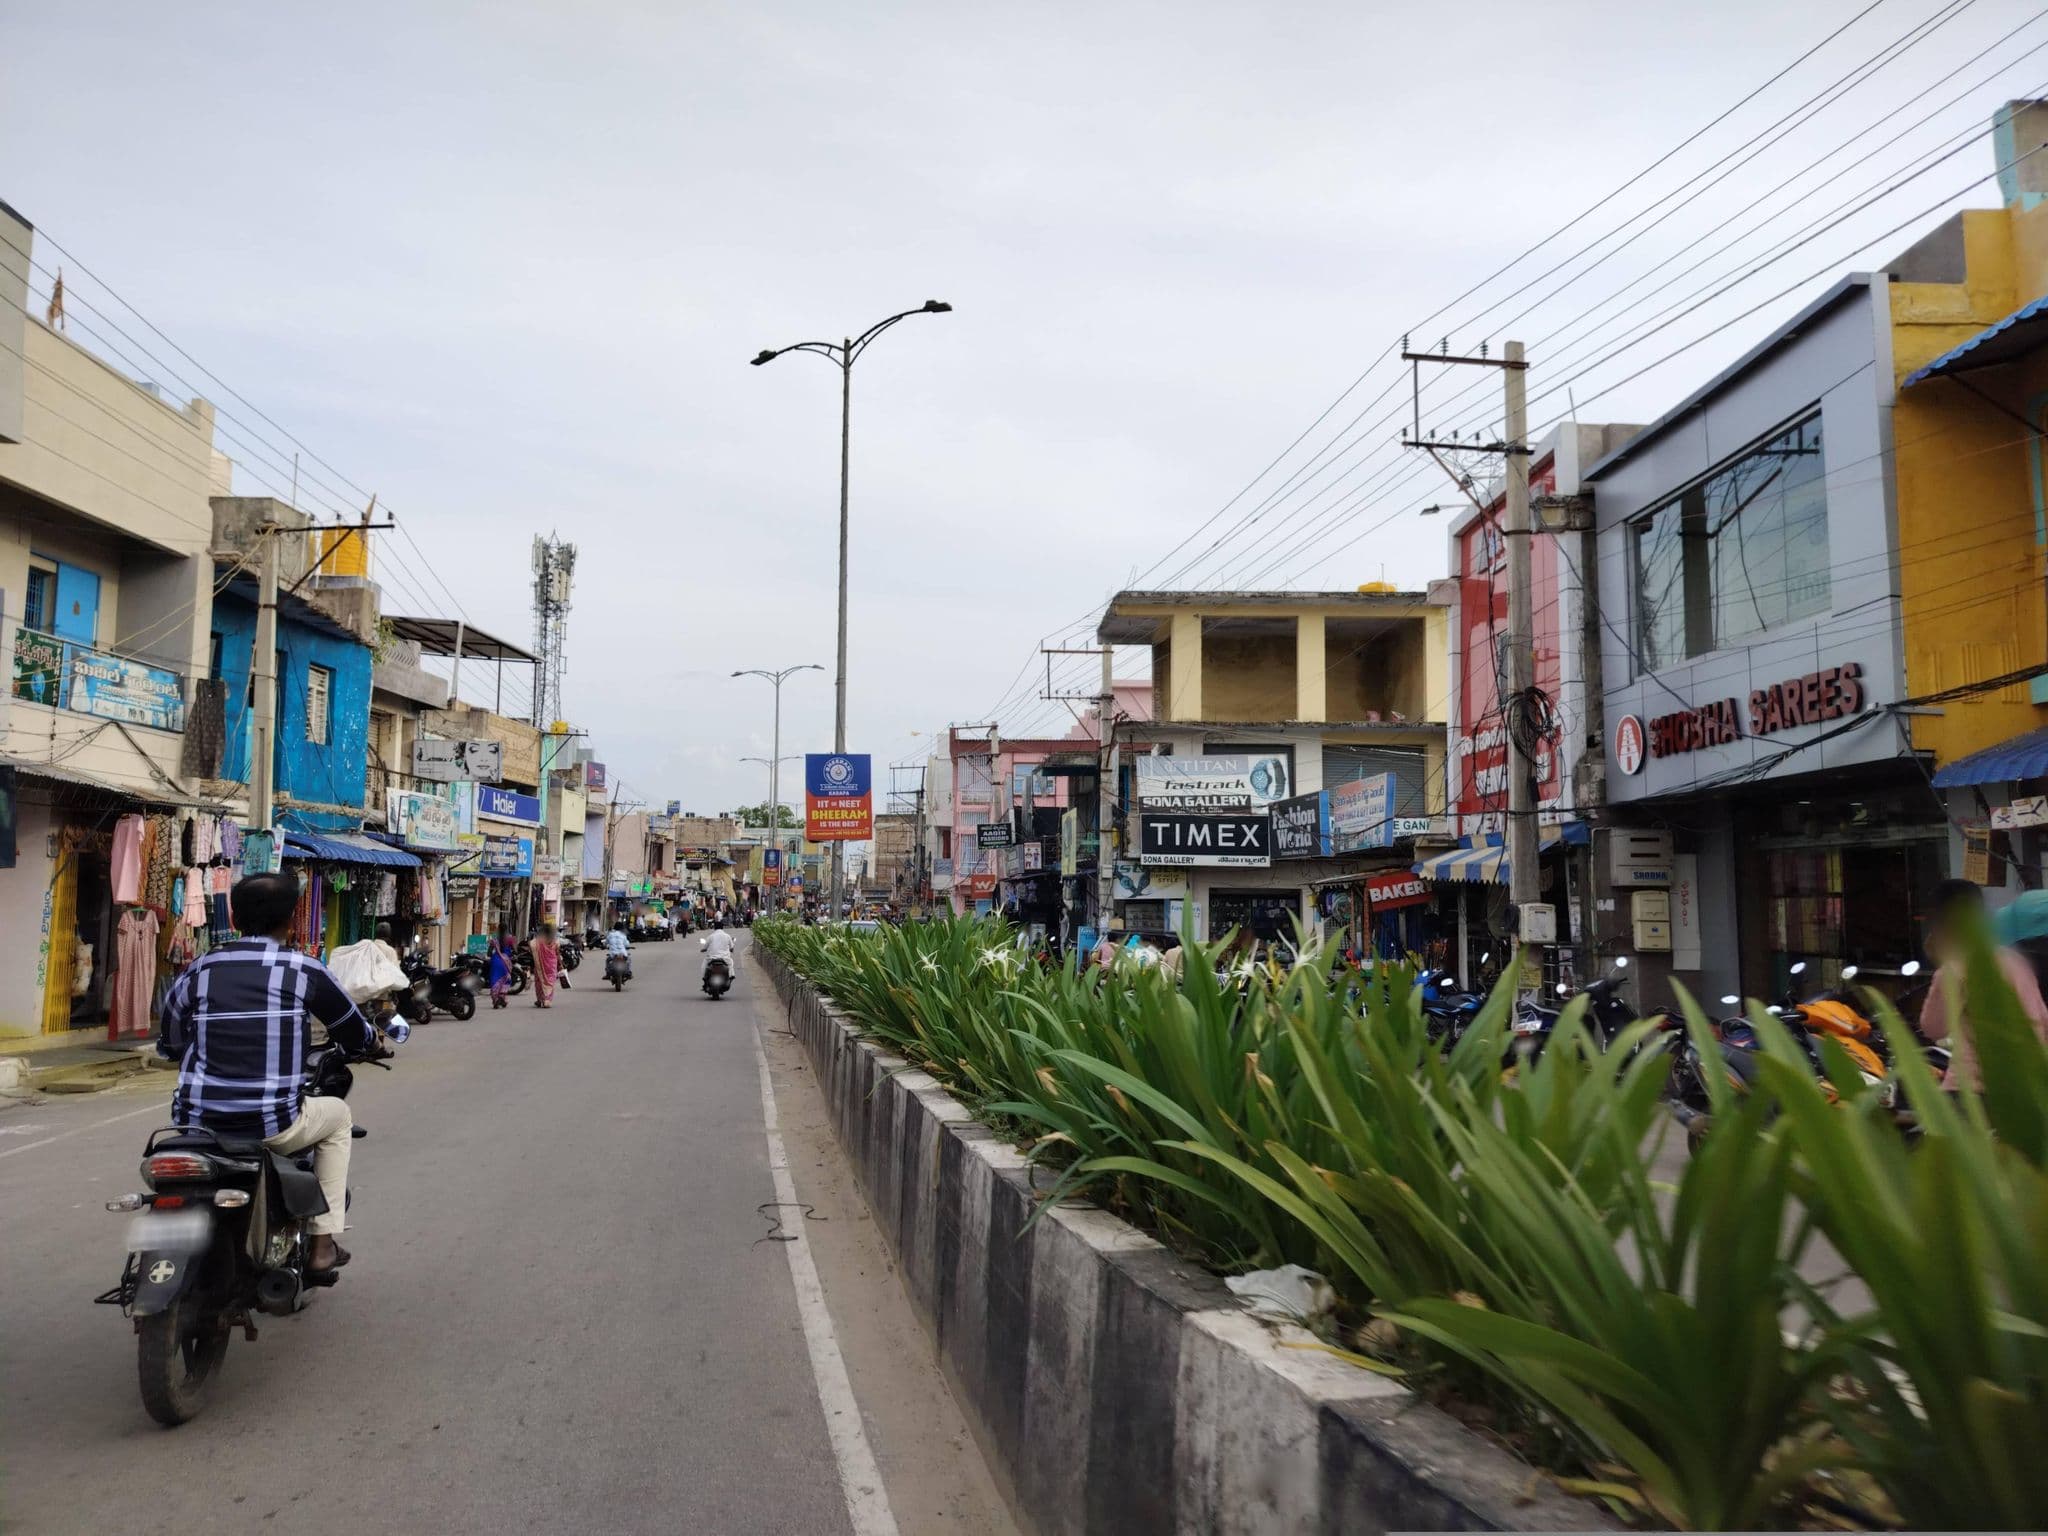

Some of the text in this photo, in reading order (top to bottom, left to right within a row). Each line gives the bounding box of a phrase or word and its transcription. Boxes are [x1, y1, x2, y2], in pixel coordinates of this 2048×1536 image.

[1748, 661, 1863, 735] SAREES
[1180, 761, 1238, 772] TITAN
[1164, 780, 1246, 790] fastrack
[492, 791, 517, 816] Haier
[817, 800, 829, 808] IIT
[838, 799, 862, 808] NEET
[1142, 795, 1248, 808] SONA GALLERY
[811, 809, 868, 820] BHEERAM
[1272, 805, 1316, 830] Fashion
[841, 820, 859, 828] BEST
[1149, 822, 1260, 847] TIMEX
[1276, 825, 1313, 849] World
[1143, 856, 1195, 864] SONA GALLERY
[1633, 872, 1669, 880] SHOBHA
